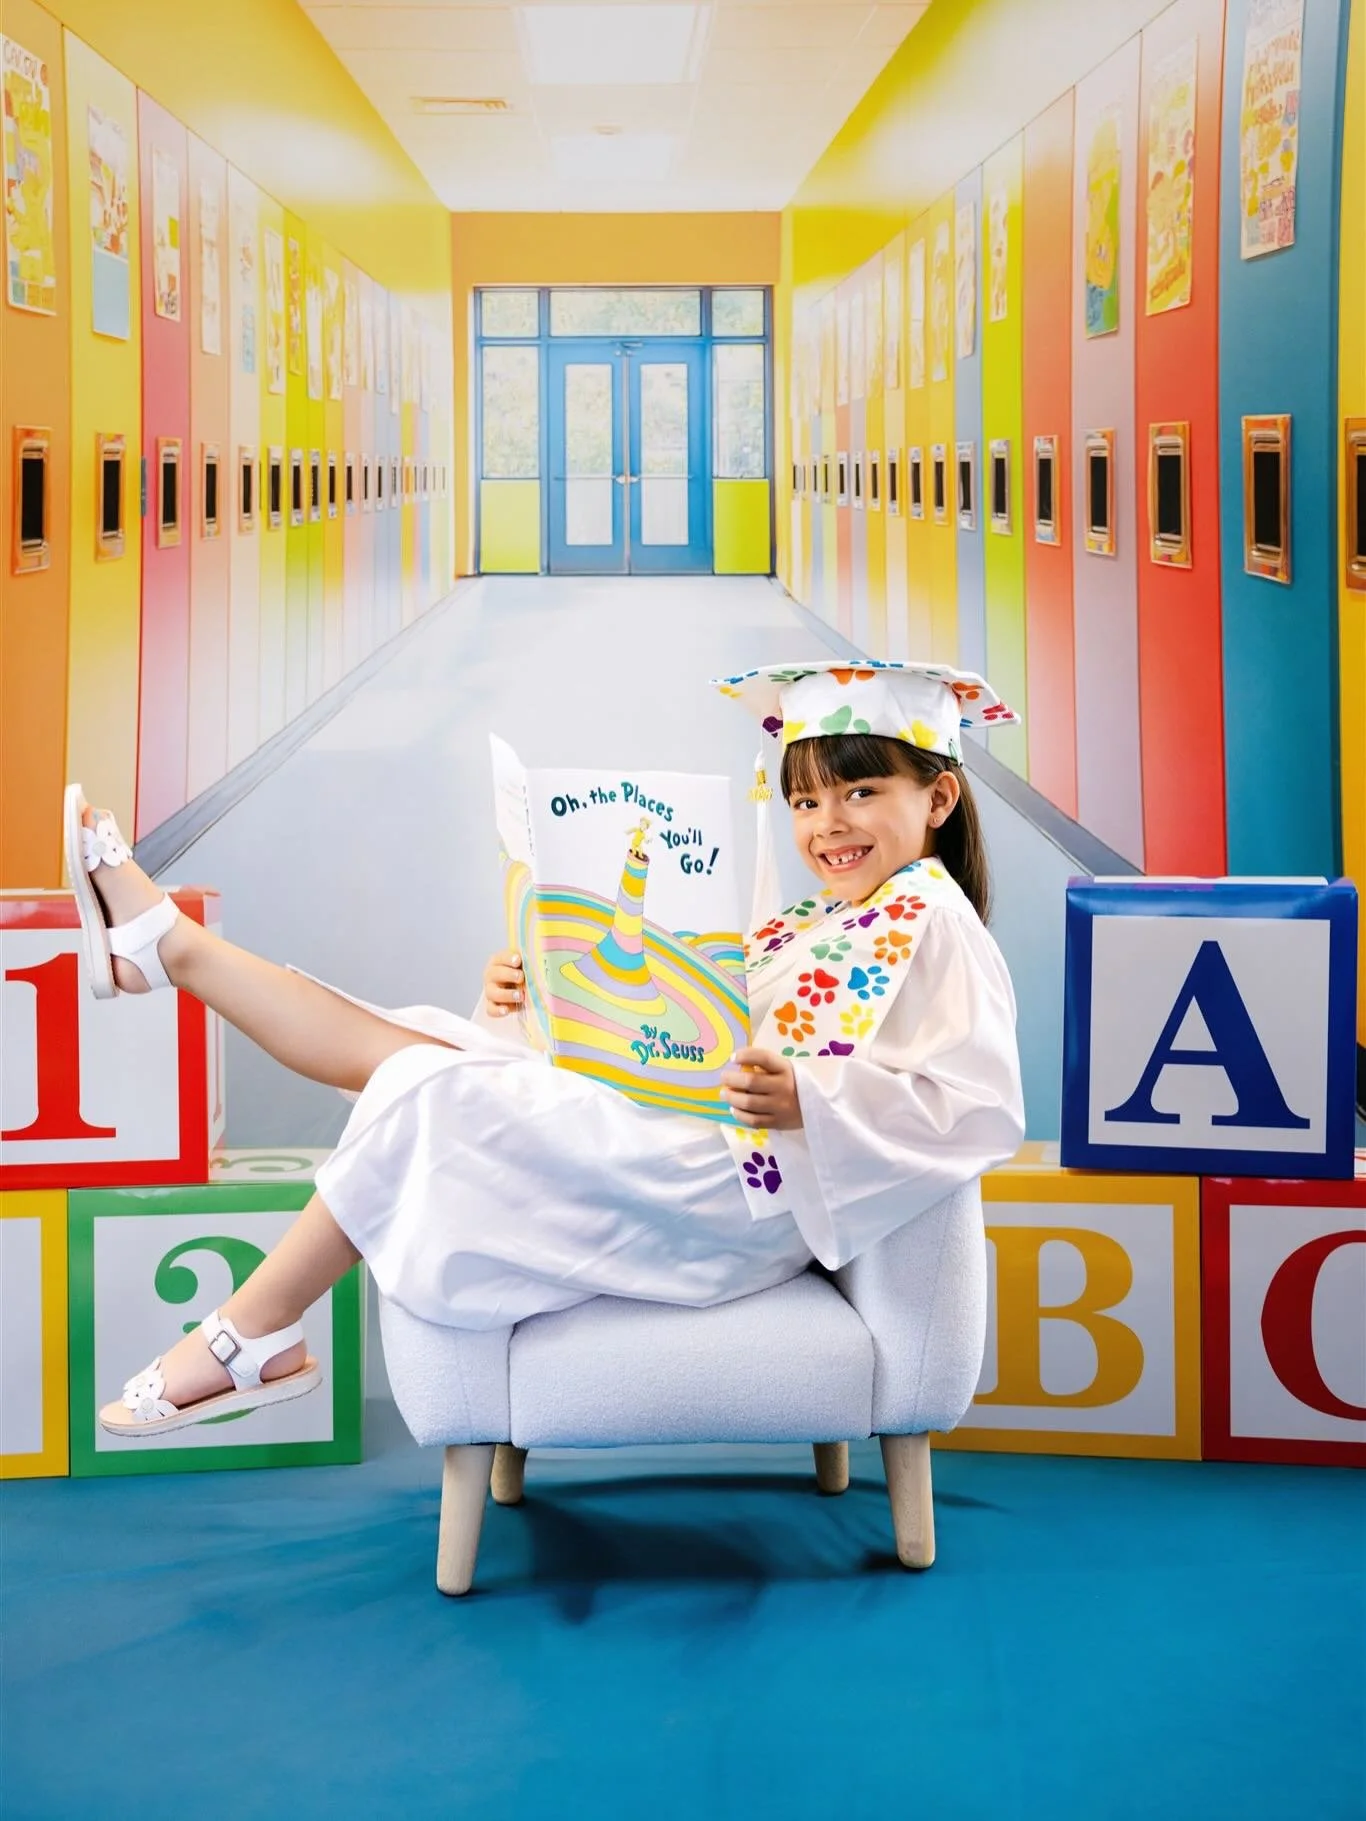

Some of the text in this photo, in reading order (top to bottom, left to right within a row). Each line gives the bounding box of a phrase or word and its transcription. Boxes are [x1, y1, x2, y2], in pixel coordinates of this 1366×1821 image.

[551, 781, 674, 822] Oh, the Places
[659, 827, 703, 849] You'll
[680, 847, 720, 875] Go!
[0, 952, 117, 1141] 1
[630, 1031, 705, 1065] Dr. Seuss
[640, 1024, 657, 1039] By
[1104, 940, 1310, 1129] A
[973, 1226, 1144, 1408] B
[1261, 1230, 1366, 1421] C
